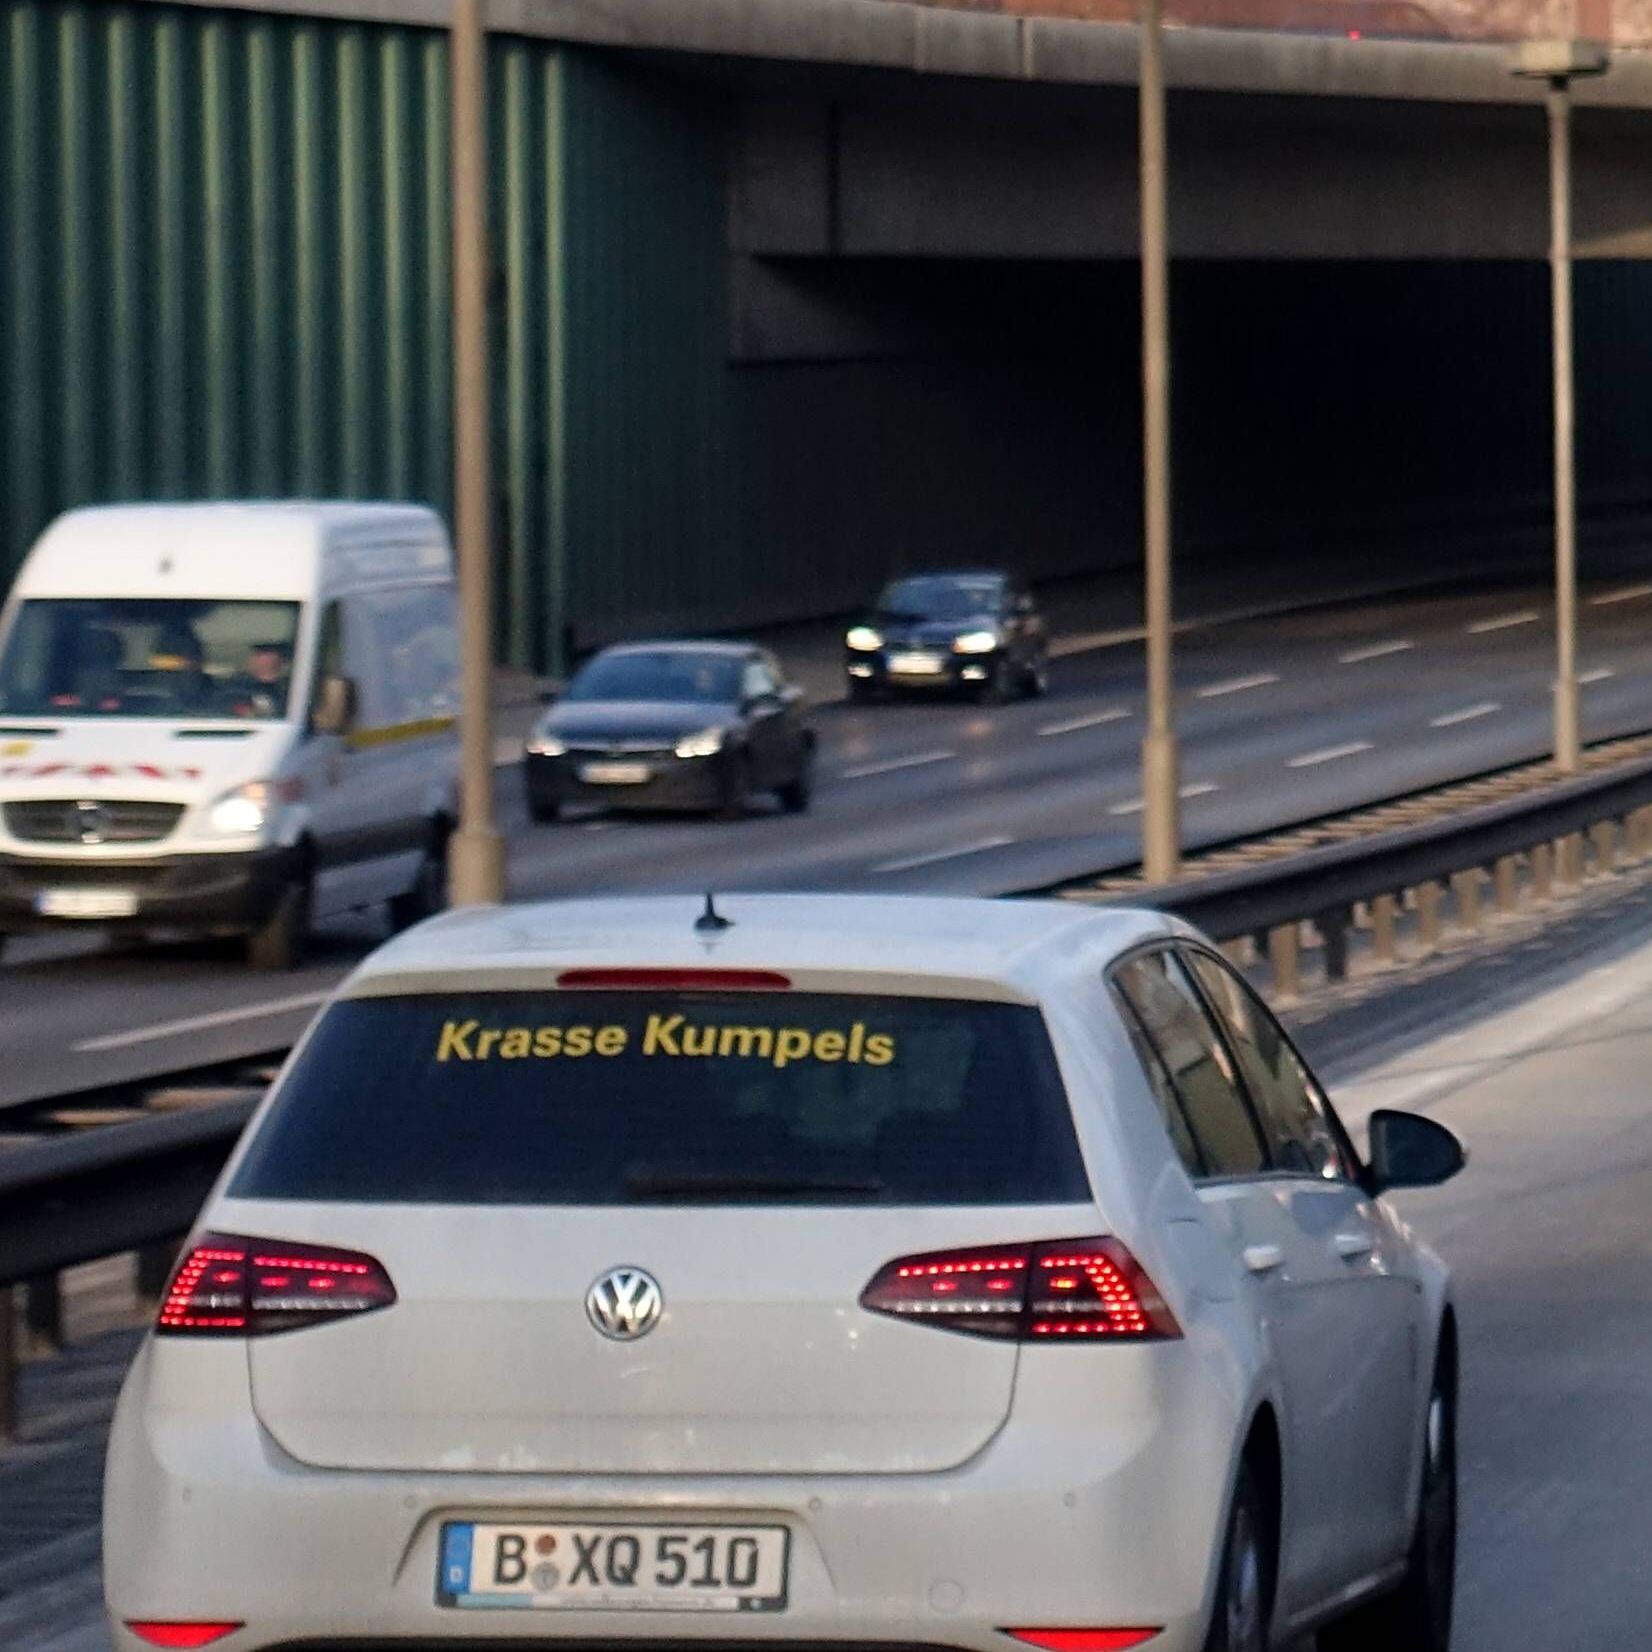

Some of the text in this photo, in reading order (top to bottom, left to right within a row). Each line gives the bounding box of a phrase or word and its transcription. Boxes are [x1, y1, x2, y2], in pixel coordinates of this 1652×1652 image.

[436, 1013, 896, 1069] Krasse Kumpels
[493, 1533, 760, 1588] B XQ 510
